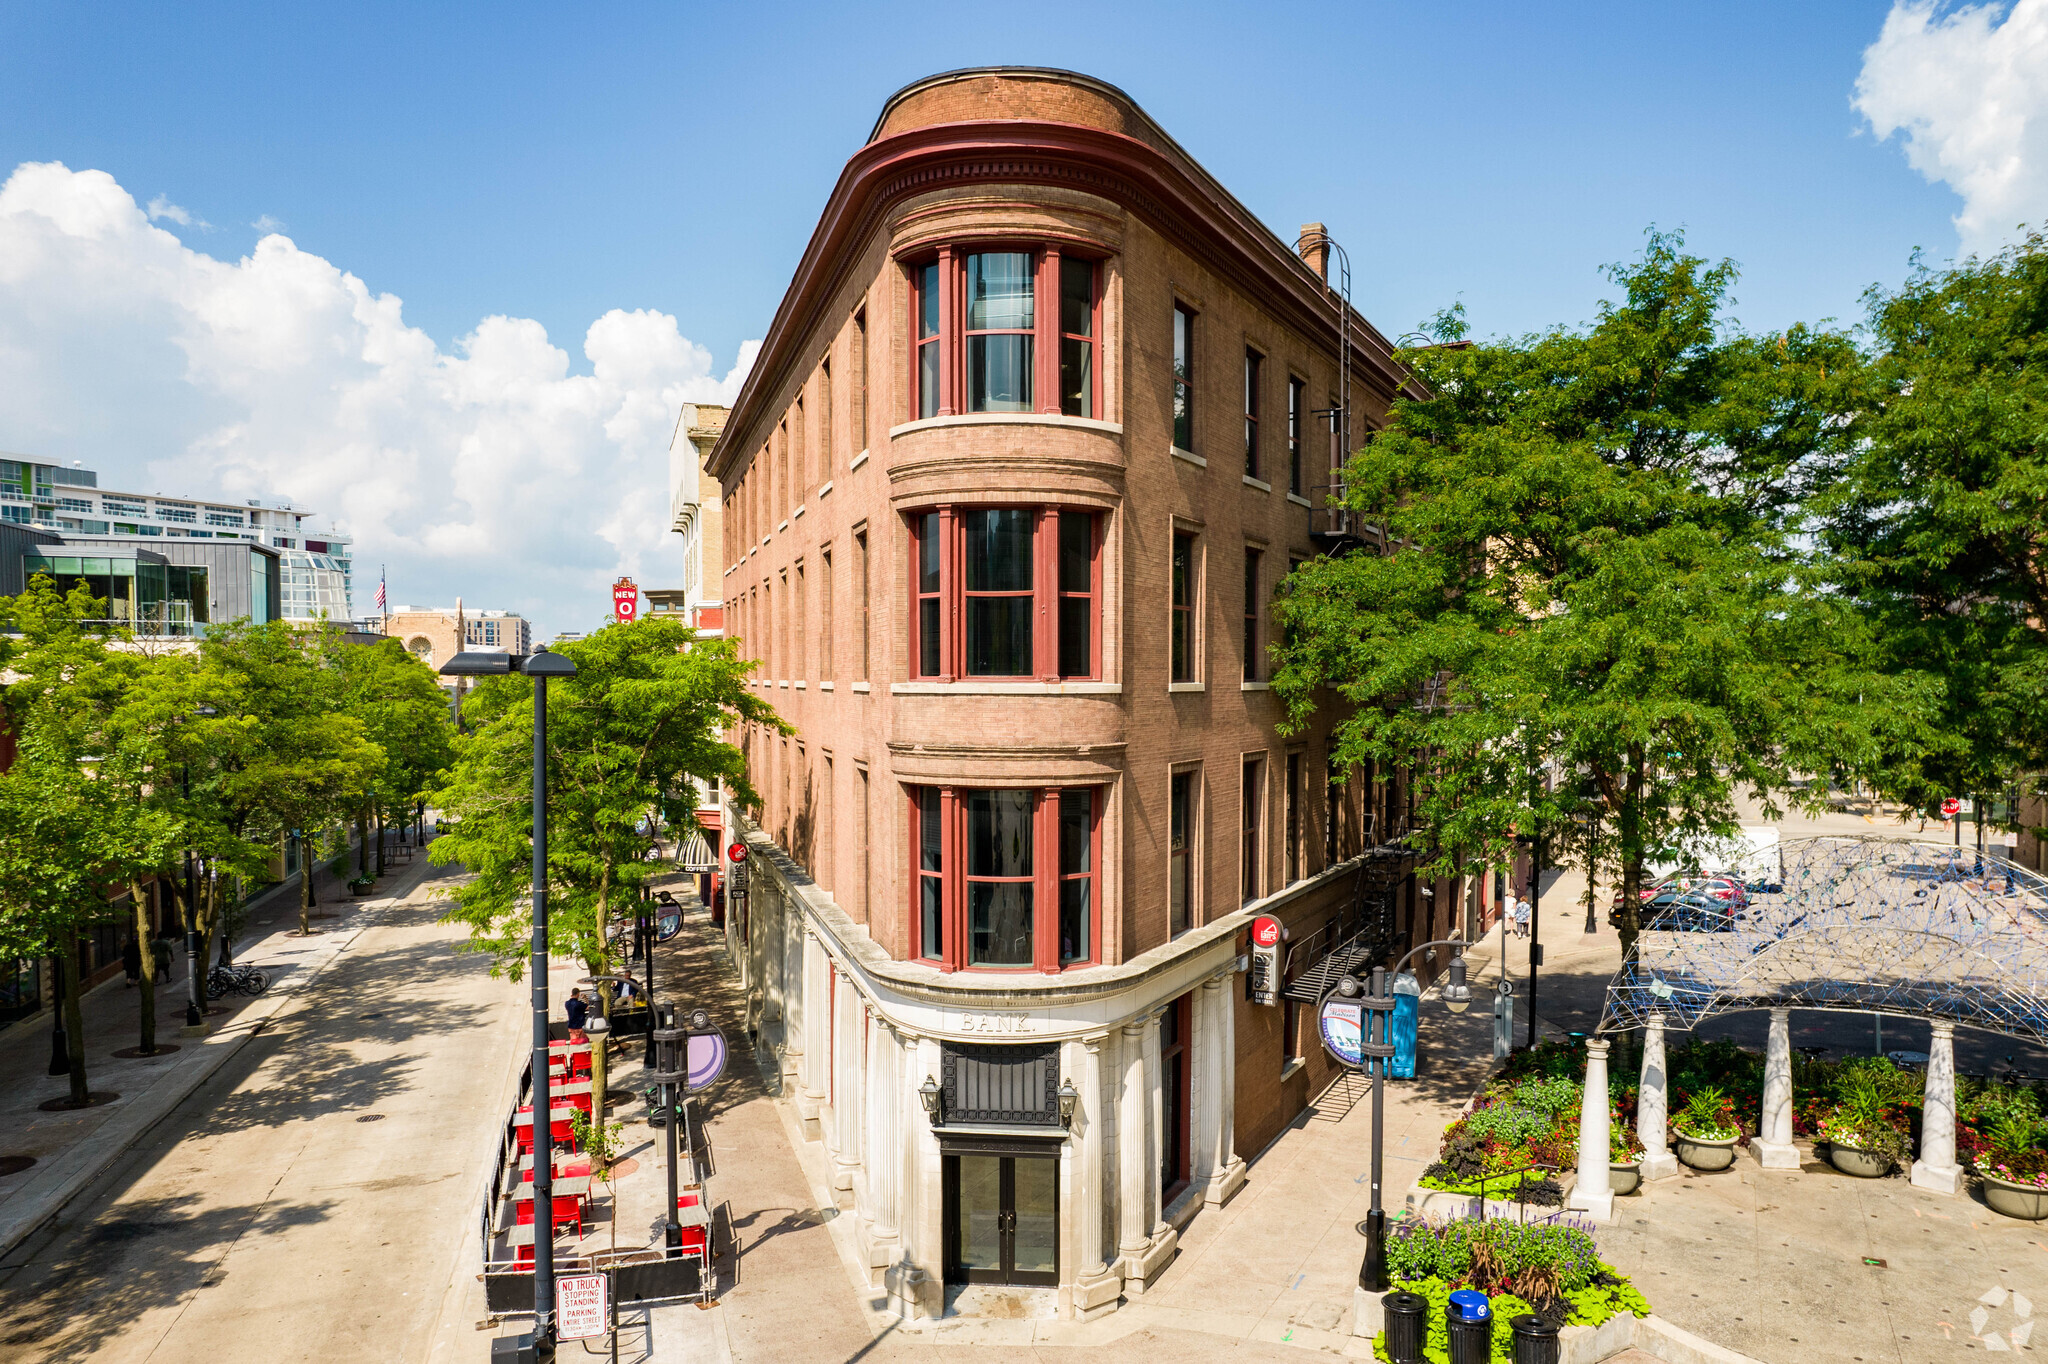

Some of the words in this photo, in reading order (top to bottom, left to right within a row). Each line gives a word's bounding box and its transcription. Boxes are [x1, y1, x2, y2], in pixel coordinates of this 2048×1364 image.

[615, 590, 635, 599] NEW
[1942, 802, 1959, 810] STOP
[1255, 991, 1274, 1000] ENTER
[1328, 1010, 1356, 1018] Madison
[562, 1281, 573, 1291] NO
[576, 1278, 601, 1290] TRUCK
[564, 1289, 599, 1299] STOPPING
[565, 1297, 599, 1307] STANDING
[567, 1308, 597, 1318] PARKING
[563, 1318, 581, 1327] ENTIRE
[583, 1316, 601, 1324] STREET
